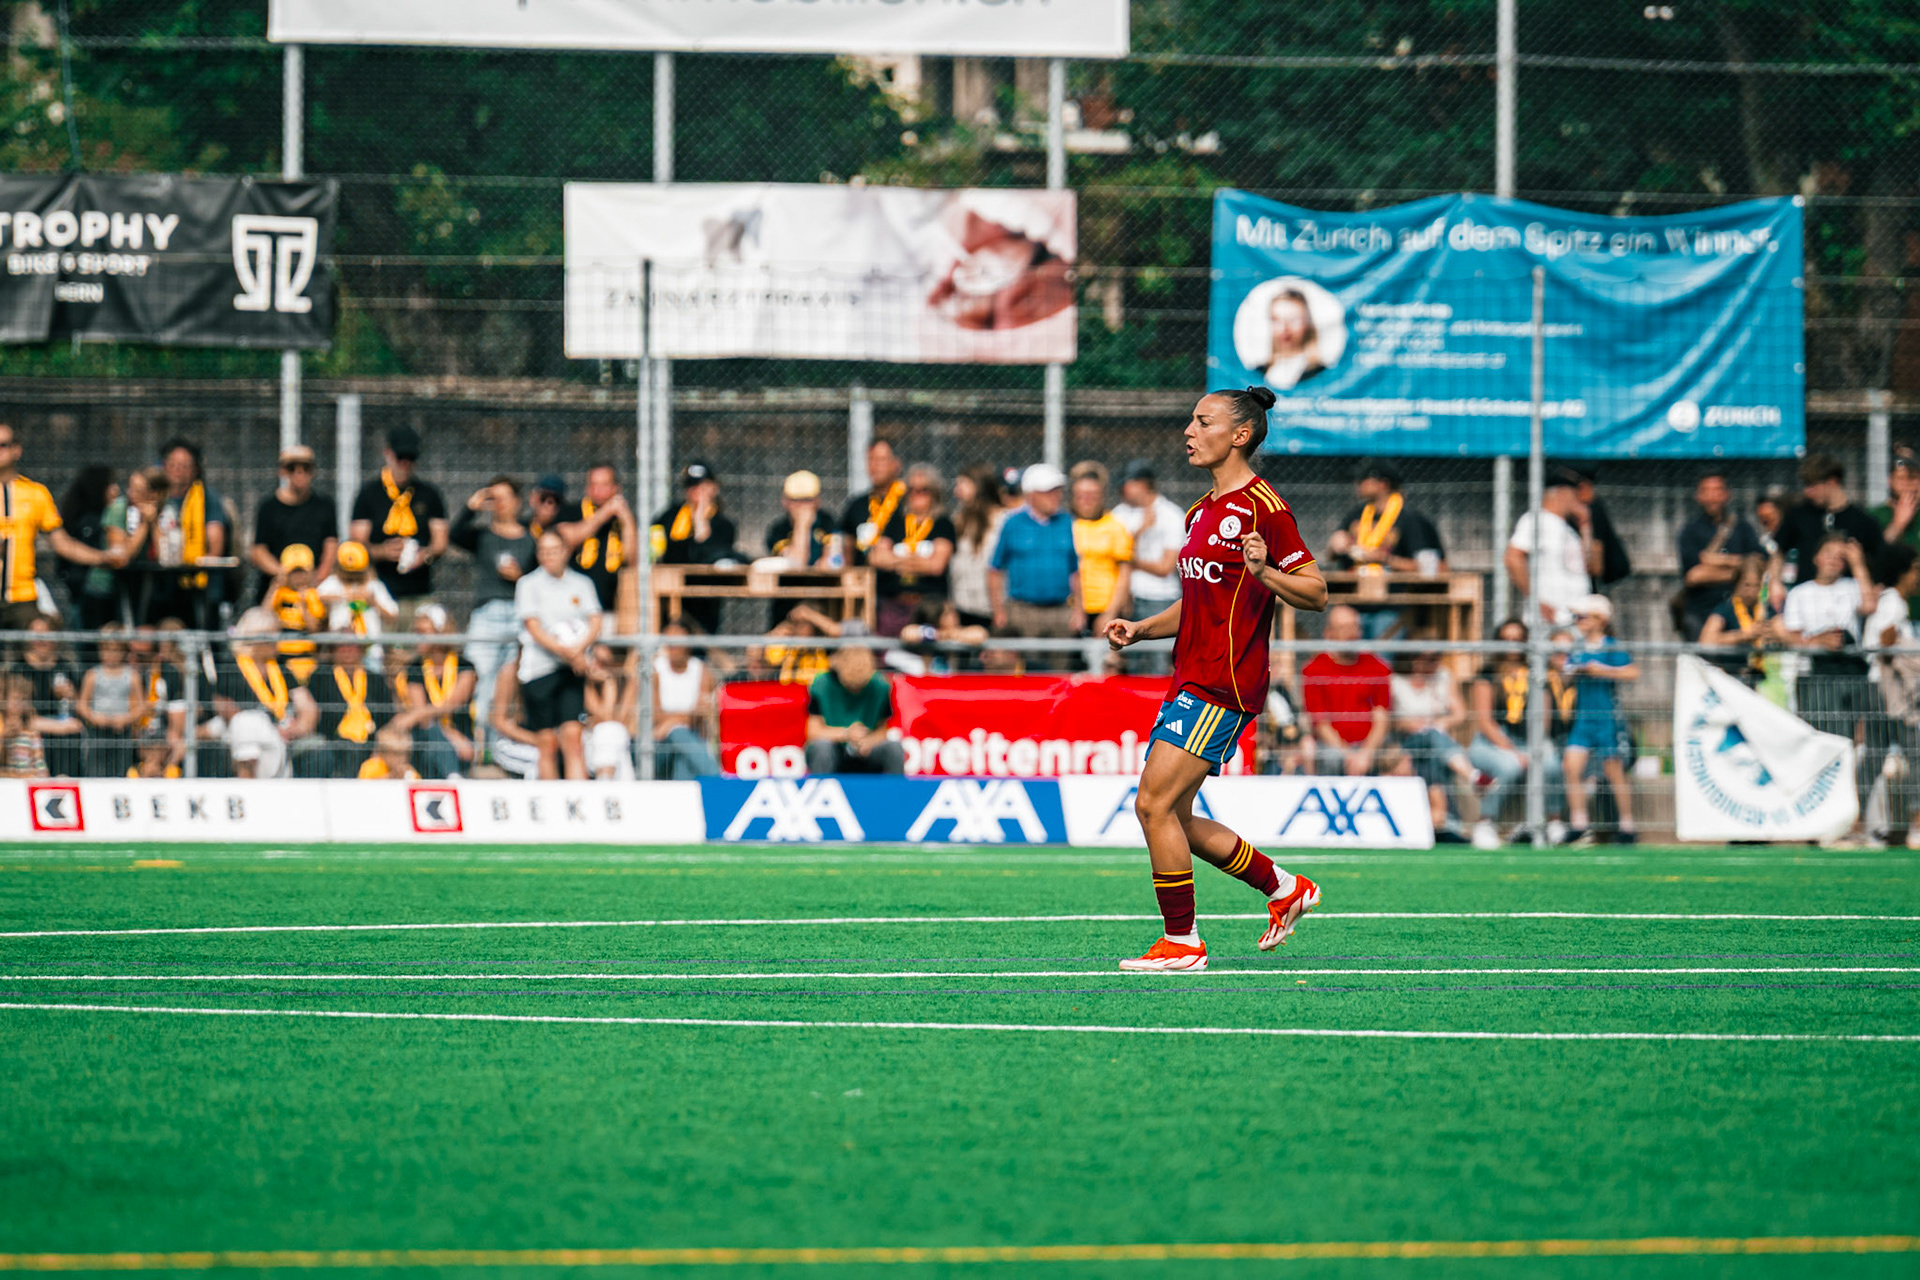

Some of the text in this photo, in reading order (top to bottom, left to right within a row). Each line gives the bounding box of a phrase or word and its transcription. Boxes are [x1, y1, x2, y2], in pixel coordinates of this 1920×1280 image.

[1236, 214, 1286, 250] Mit
[1399, 216, 1446, 251] auf
[1448, 217, 1521, 251] dem
[77, 253, 150, 277] SPORT
[1182, 557, 1223, 583] MSC
[111, 793, 246, 822] BEKB
[489, 796, 623, 824] BEKB
[722, 778, 867, 842] AXA
[905, 778, 1049, 843] AXA
[1279, 787, 1402, 837] AXA
